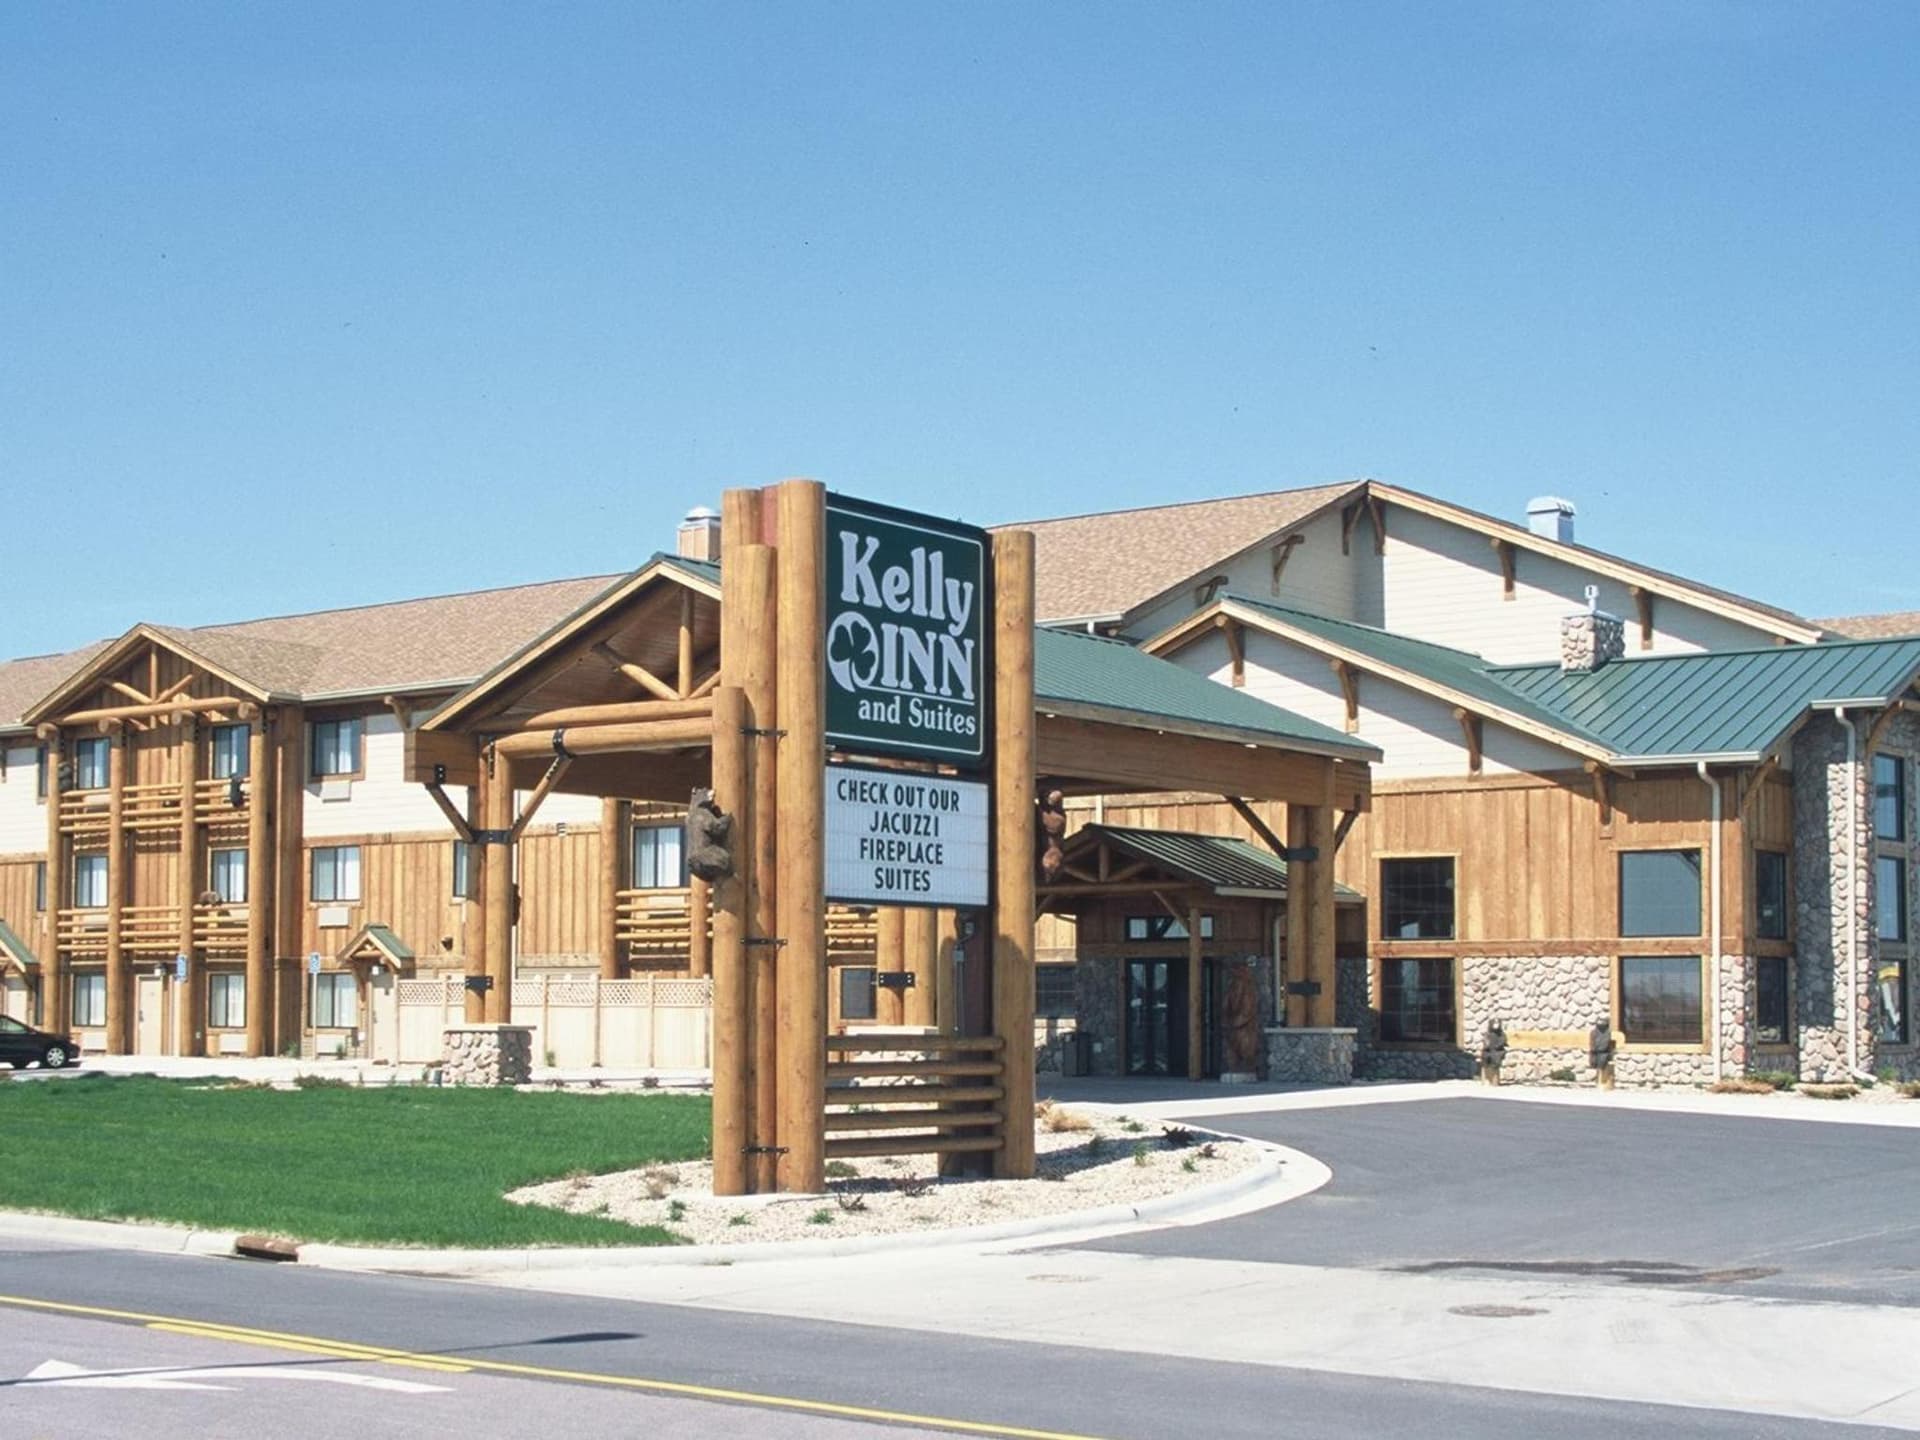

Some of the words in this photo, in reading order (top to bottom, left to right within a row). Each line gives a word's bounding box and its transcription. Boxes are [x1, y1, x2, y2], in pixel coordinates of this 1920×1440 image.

[840, 531, 973, 636] Kelly
[881, 623, 975, 700] INN
[858, 696, 900, 724] and
[908, 698, 976, 735] Suites
[837, 779, 888, 804] CHECK
[894, 785, 925, 808] OUT
[929, 789, 959, 811] OUR
[870, 811, 939, 837] JACUZZI
[860, 838, 943, 864] FIREPLACE
[874, 867, 931, 892] SUITES
